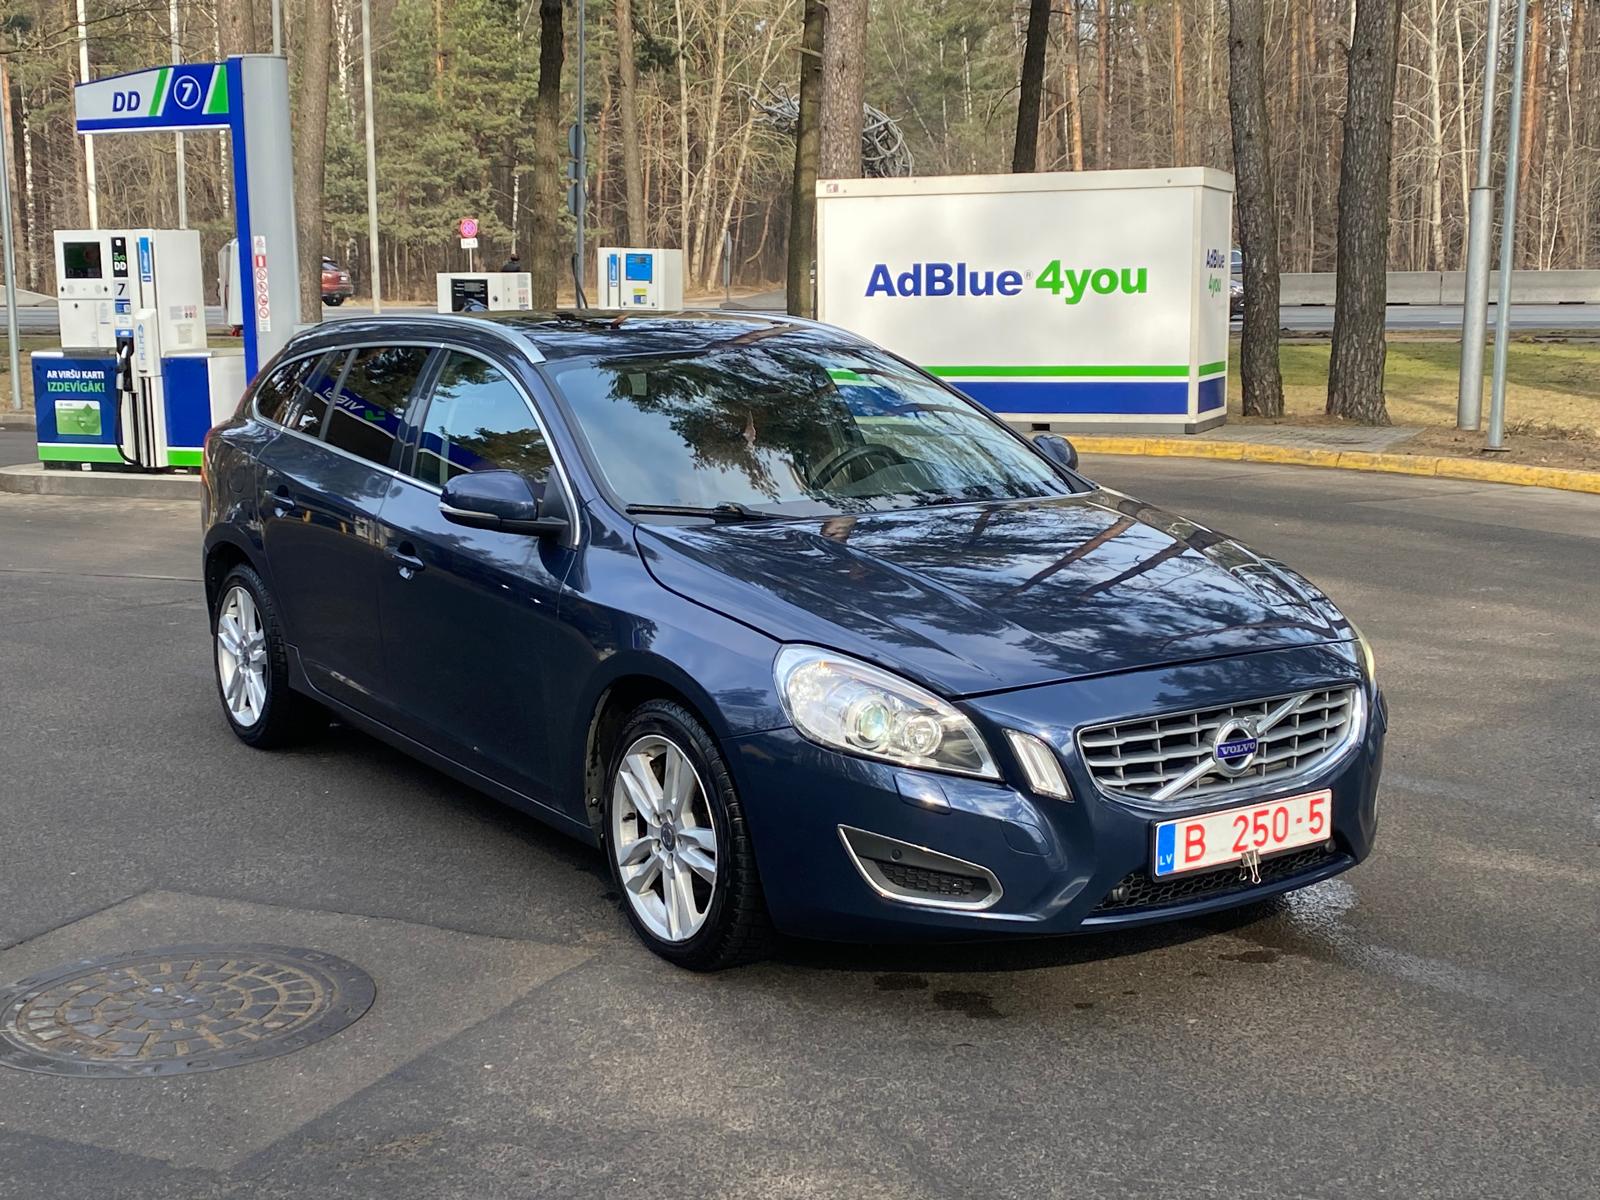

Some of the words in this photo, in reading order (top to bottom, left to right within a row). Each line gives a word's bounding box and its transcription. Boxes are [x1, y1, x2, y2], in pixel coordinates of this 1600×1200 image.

[112, 91, 140, 112] DD
[182, 83, 193, 102] 7
[1206, 248, 1225, 268] AdBlue
[117, 283, 126, 296] 7
[1035, 260, 1147, 304] 4you
[1209, 273, 1221, 298] 4you
[47, 370, 58, 379] AR
[82, 370, 104, 379] KARTI
[48, 380, 105, 392] IZDEVĪGĀK!
[1220, 742, 1256, 755] VOLVO
[1185, 823, 1206, 863] B
[1160, 853, 1173, 866] LV
